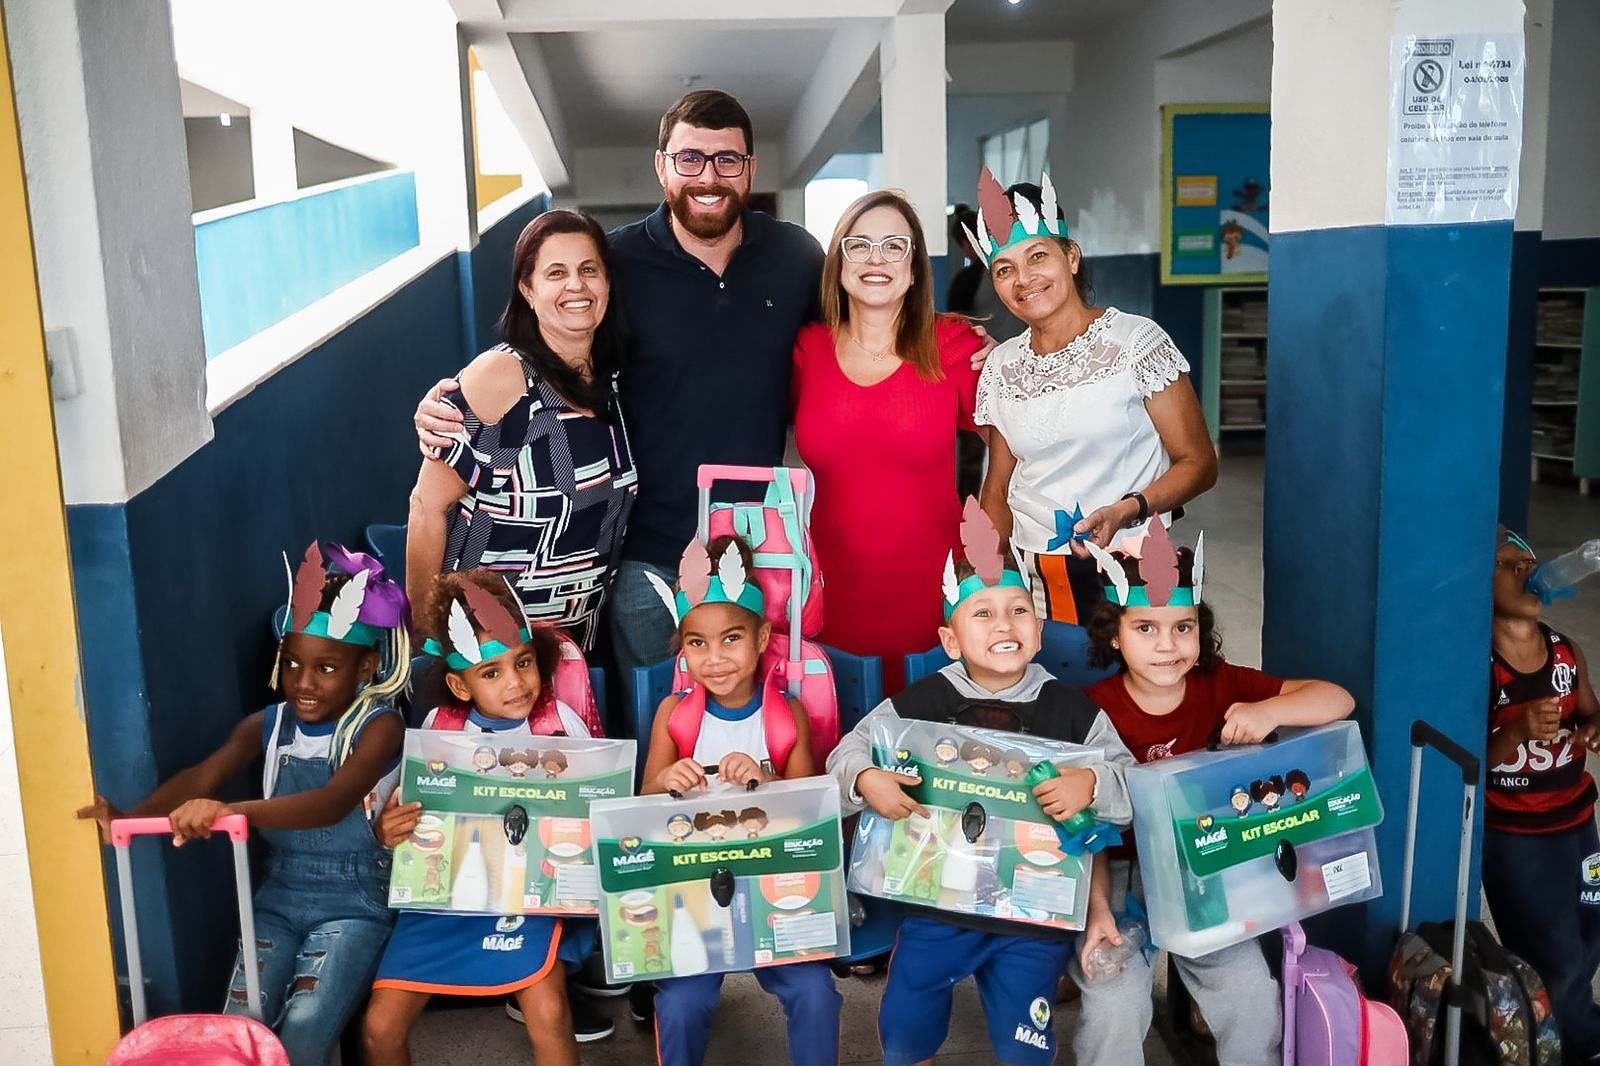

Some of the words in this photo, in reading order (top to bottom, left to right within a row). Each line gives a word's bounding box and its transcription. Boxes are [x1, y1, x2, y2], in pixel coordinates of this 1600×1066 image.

[1410, 44, 1450, 54] ROIBIDO
[1412, 95, 1429, 103] USO
[1408, 104, 1445, 112] CELUAR
[883, 764, 919, 777] MAGÉ
[417, 775, 456, 787] MAGÉ
[473, 786, 497, 797] KIT
[499, 787, 566, 800] ESCOLAR
[932, 777, 957, 790] KIT
[958, 782, 1027, 803] ESCOLAR
[1242, 826, 1261, 842] KIT
[1263, 809, 1320, 836] ESCOLAR
[1194, 826, 1228, 849] MAGÉ
[612, 848, 656, 867] MAGÉ
[673, 853, 698, 866] KIT
[700, 847, 772, 863] ESCOLAR
[482, 934, 524, 951] MAGÉ
[1015, 1026, 1049, 1050] MAG
